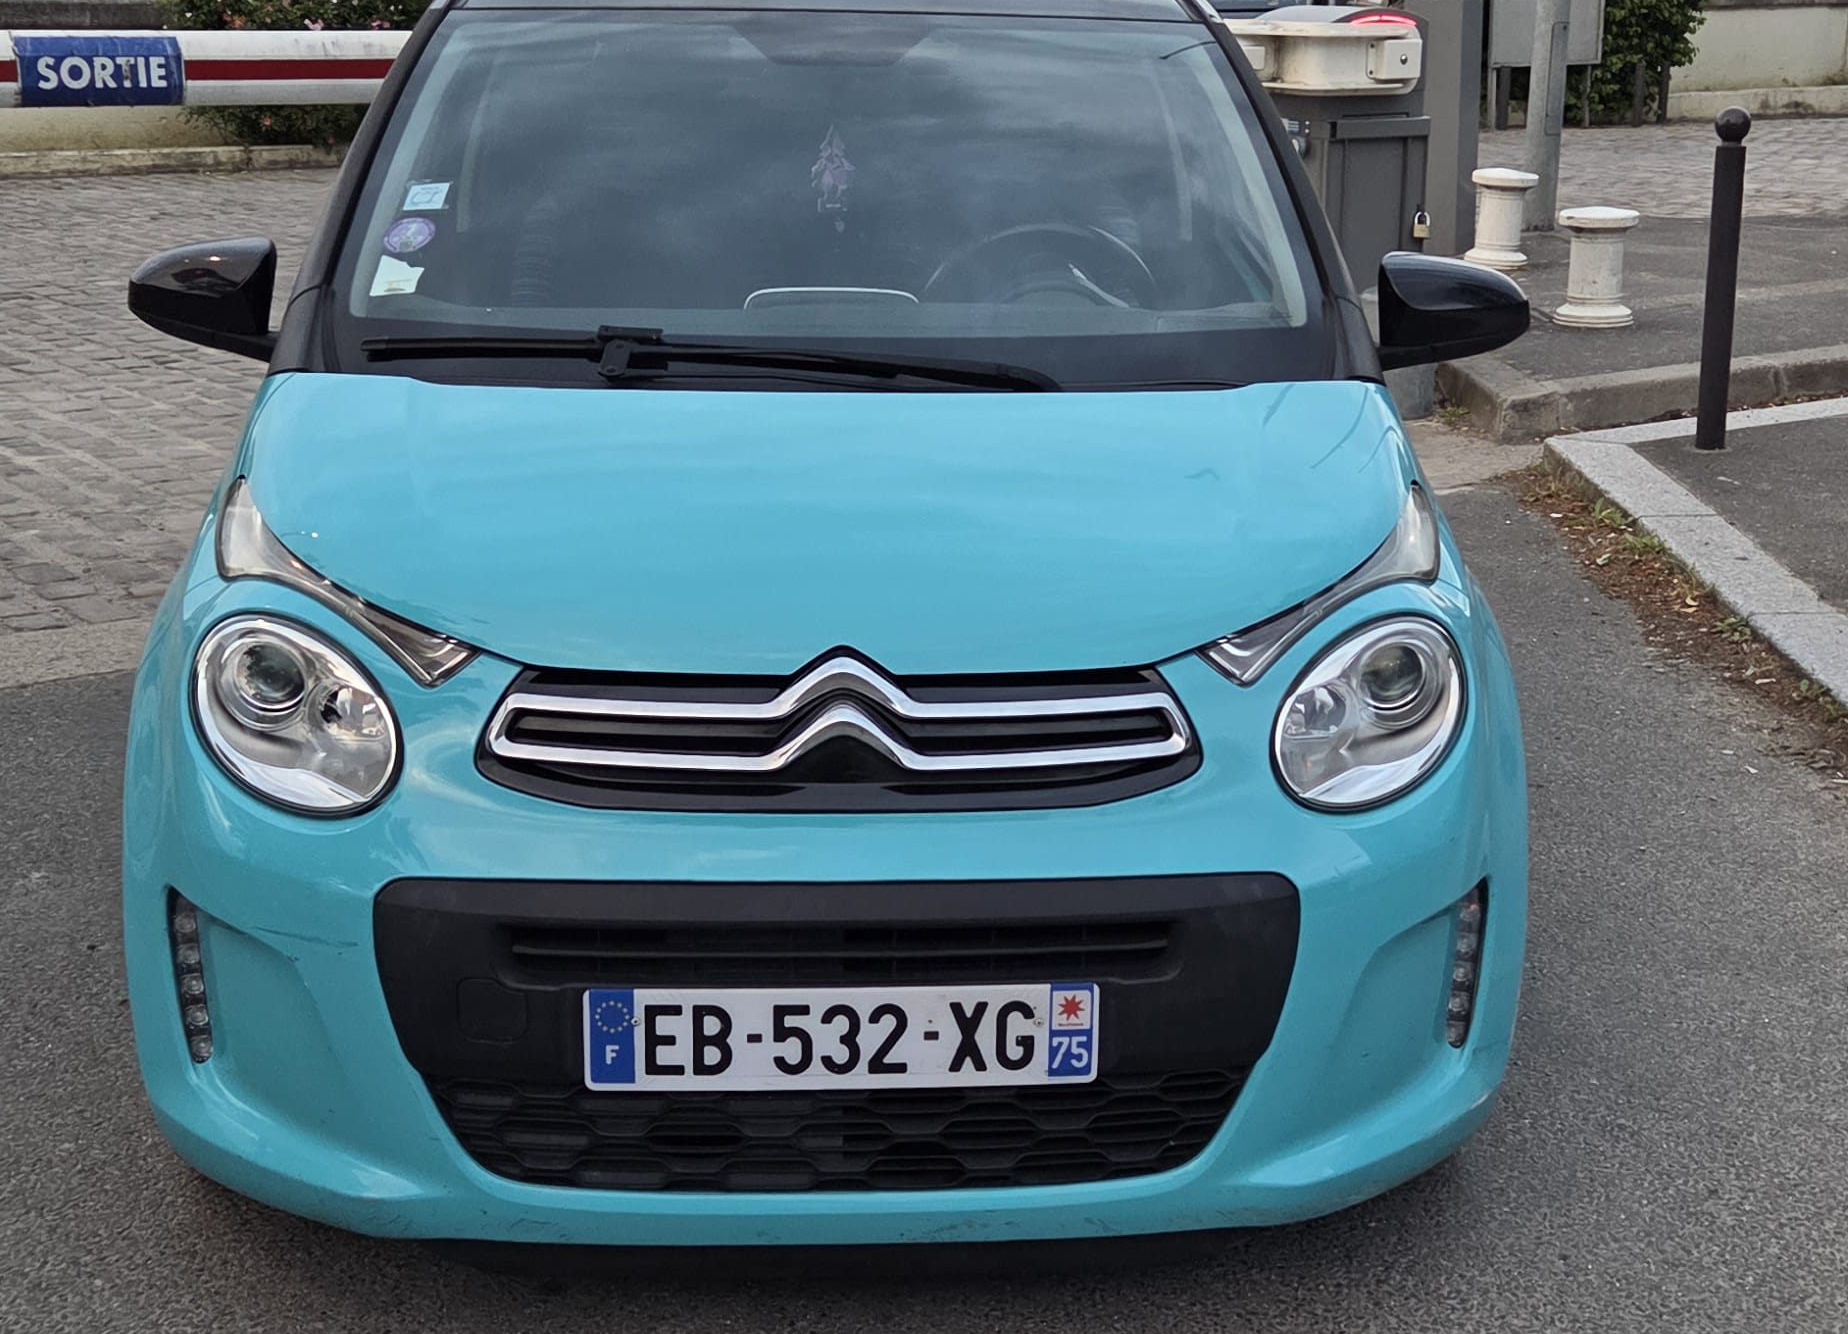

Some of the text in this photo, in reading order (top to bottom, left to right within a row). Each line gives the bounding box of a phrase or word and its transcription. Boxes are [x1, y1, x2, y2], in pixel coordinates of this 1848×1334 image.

[37, 56, 168, 90] SORTIE
[605, 1000, 1089, 1076] F EB-532-XG 75
